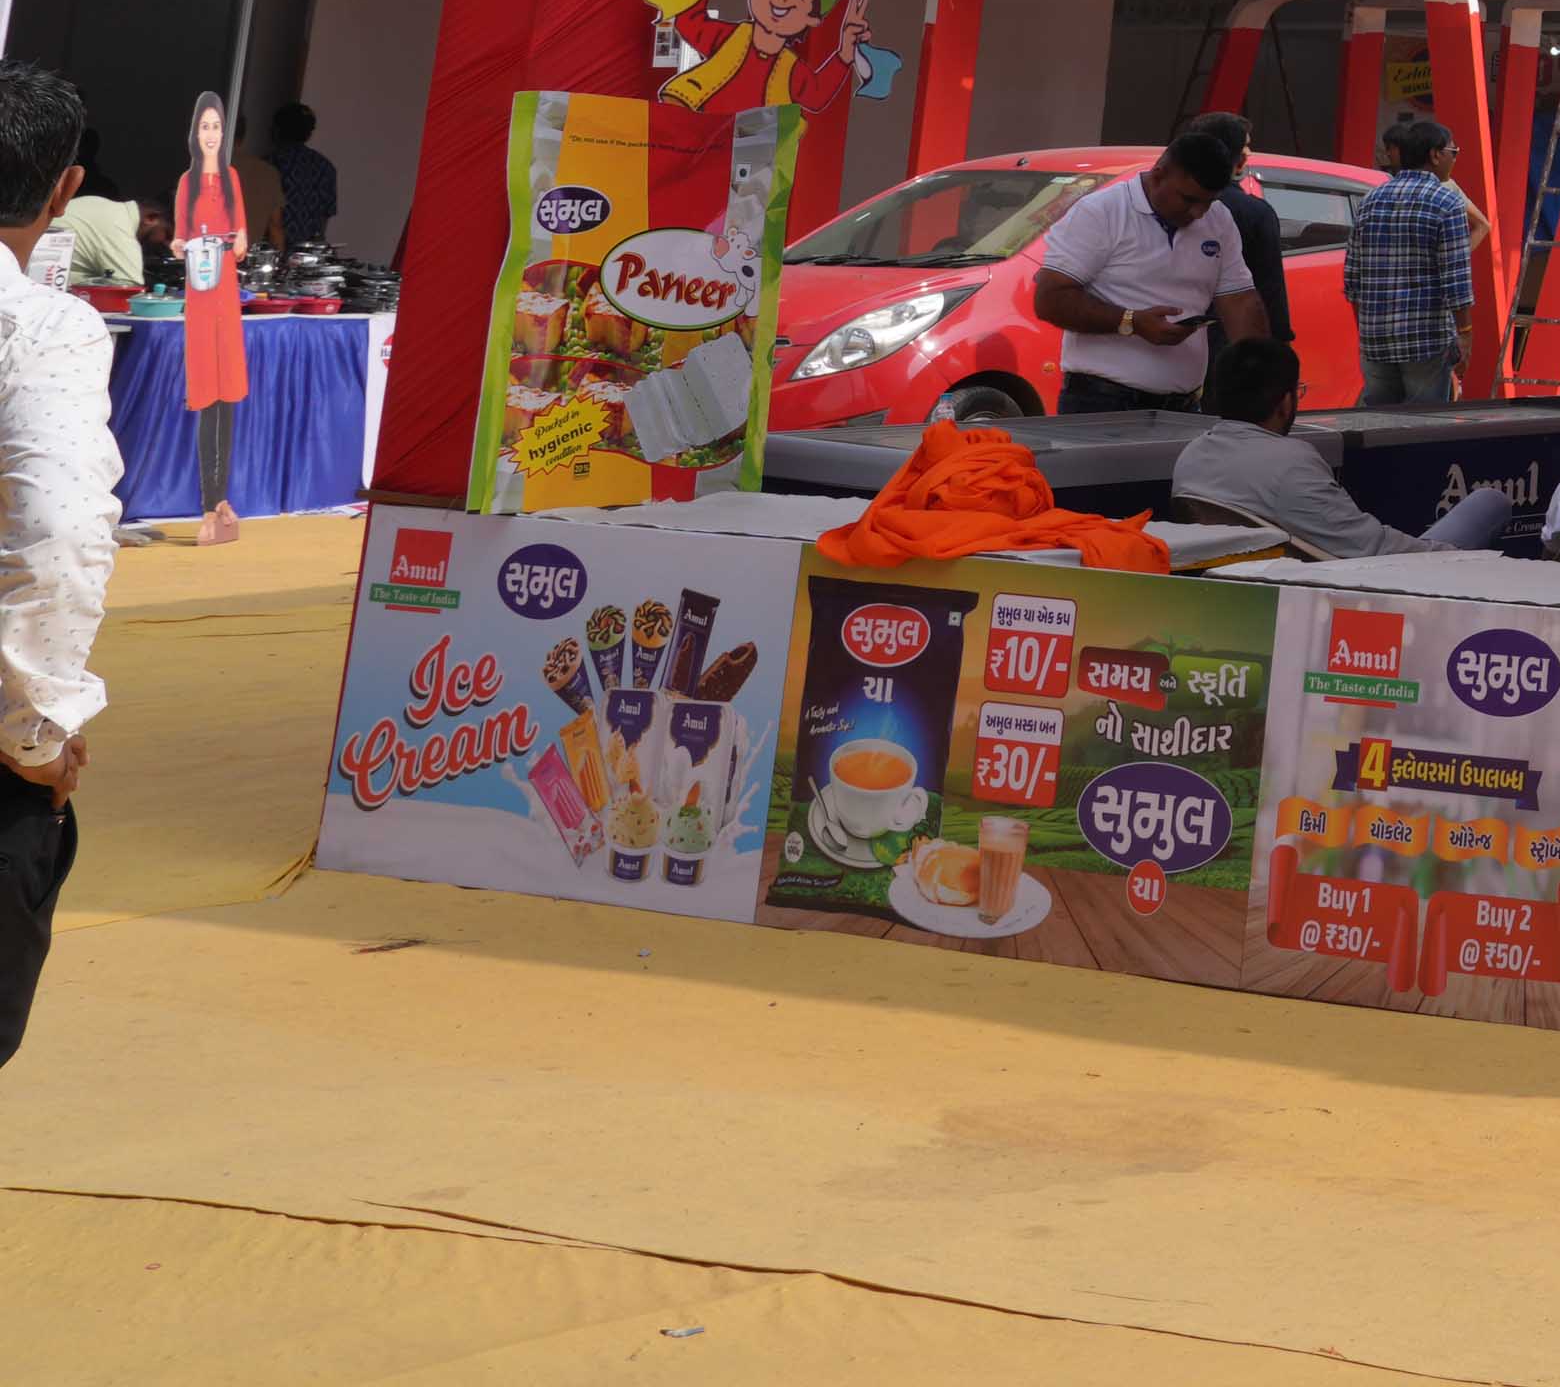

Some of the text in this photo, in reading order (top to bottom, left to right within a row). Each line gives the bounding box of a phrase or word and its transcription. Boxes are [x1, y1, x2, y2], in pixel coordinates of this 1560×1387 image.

[540, 200, 602, 229] સુમુલ
[613, 253, 736, 312] Paneer
[528, 423, 592, 460] hygienic
[392, 556, 445, 582] Amul
[505, 564, 580, 607] સુમુલ
[849, 616, 922, 655] સુમુલ
[1330, 640, 1398, 671] Amul
[406, 635, 502, 722] Ice
[990, 636, 1068, 690] ₹10/-
[1456, 648, 1551, 704] સુમુલ
[862, 675, 893, 703] ચા
[1095, 701, 1234, 757] નો સાથીદાર
[341, 703, 538, 806] Cream
[977, 750, 1056, 800] ₹30/-
[1091, 784, 1217, 861] સુમુલ
